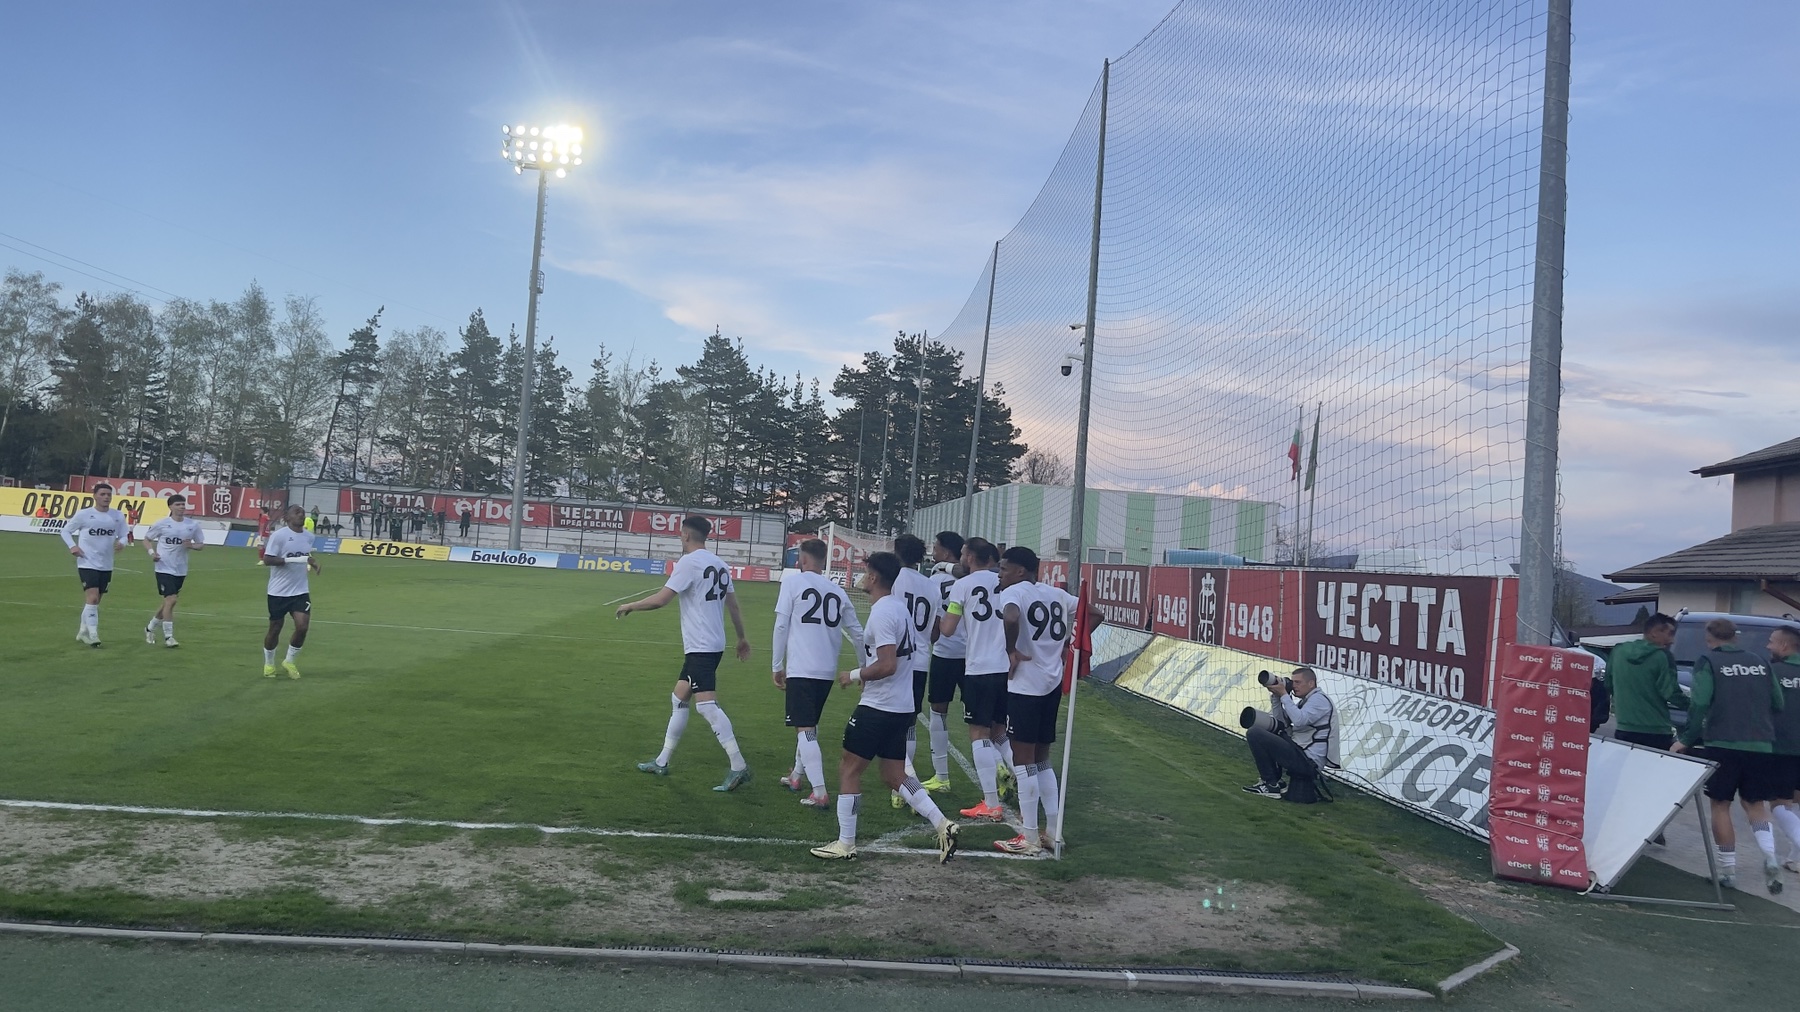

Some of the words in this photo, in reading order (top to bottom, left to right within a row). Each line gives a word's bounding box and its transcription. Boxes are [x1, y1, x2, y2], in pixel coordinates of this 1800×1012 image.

[560, 506, 623, 521] ЧЕСТТА
[590, 520, 623, 529] ВСИЧКО
[361, 541, 425, 558] efbet
[471, 550, 537, 565] Бачково
[703, 565, 729, 601] 29
[1095, 569, 1140, 604] ЧЕСТТА
[801, 588, 841, 627] 20
[904, 592, 931, 632] 10
[1157, 594, 1188, 627] 1948
[1114, 606, 1140, 626] ВСИЧКО
[1316, 581, 1467, 656] ЧЕСТТА
[1027, 601, 1067, 642] 98
[1228, 602, 1274, 642] 1948
[1519, 655, 1543, 664] efbet
[1570, 662, 1589, 671] efbet
[1721, 664, 1766, 677] efbet
[1315, 643, 1371, 678] ПРЕДИ
[1377, 654, 1465, 701] ВСИЧКО
[1781, 677, 1800, 688] ef
[1513, 707, 1537, 716] efbet
[1565, 715, 1585, 723] efbet
[1511, 733, 1534, 742] efbet
[1562, 741, 1584, 750] efbet
[1508, 760, 1531, 769] efbet
[1559, 768, 1581, 776] efbet
[1506, 786, 1531, 795] efbet
[1558, 795, 1579, 803] efbet
[1504, 810, 1528, 818] efbet
[1505, 835, 1529, 844] efbet
[1556, 843, 1579, 851] efbet
[1507, 861, 1532, 869] efbet
[1559, 869, 1582, 877] efbet
